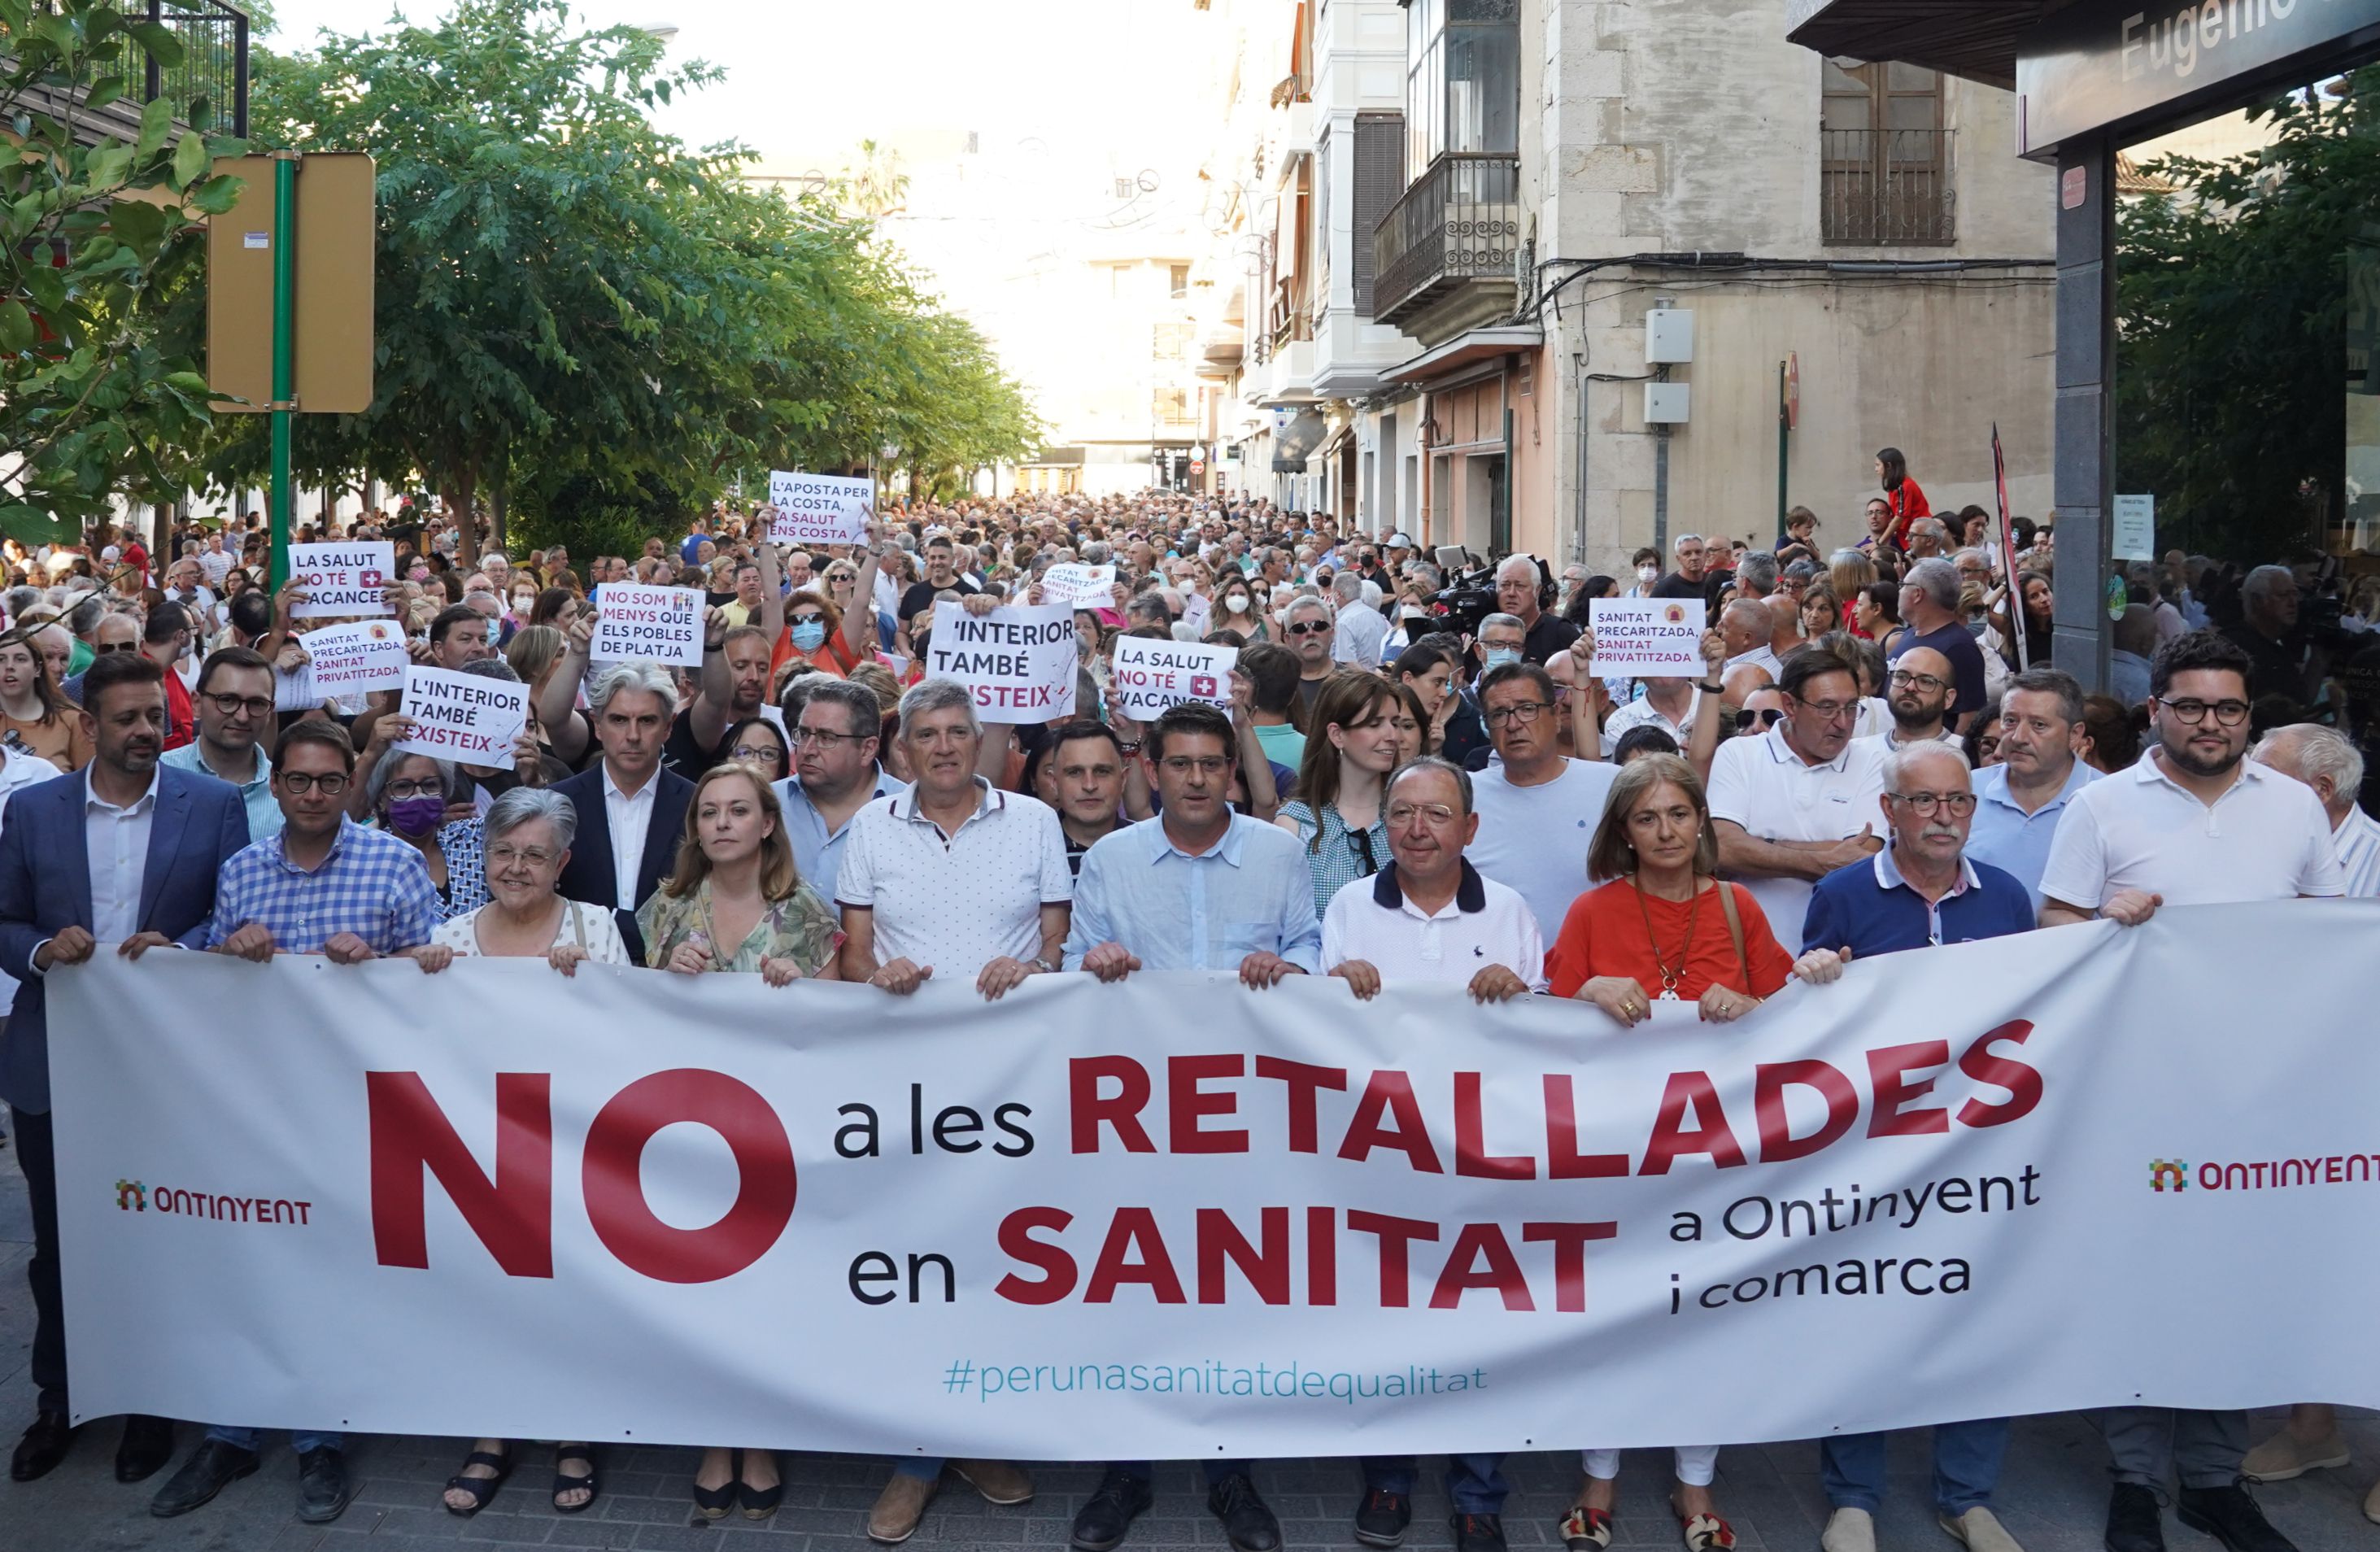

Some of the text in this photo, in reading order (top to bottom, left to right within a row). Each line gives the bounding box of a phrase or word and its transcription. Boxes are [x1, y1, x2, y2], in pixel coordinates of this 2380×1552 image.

[773, 482, 869, 498] L'APOSTA PER
[773, 496, 844, 512] LA COSTA,
[791, 512, 836, 525] SALUT
[770, 525, 847, 538] ENS COSTA
[297, 554, 376, 567] LA SALUT
[327, 569, 347, 586] TÉ
[605, 592, 666, 606] NO SOM
[604, 608, 692, 625] MENYS QUE
[1598, 613, 1652, 623] SANITAT
[310, 634, 360, 648] SANITAT
[602, 625, 692, 642] ELS POBLES
[1598, 626, 1698, 639] PRECARITZADA,
[313, 641, 404, 658] PRECARITZADA,
[601, 642, 683, 658] DE PLATJA
[1598, 640, 1652, 650] SANITAT
[316, 656, 365, 671] SANITAT
[934, 650, 1029, 677] TAMBÉ
[1121, 649, 1214, 671] LA SALUT
[1598, 653, 1691, 663] PRIVATITZADA
[317, 666, 400, 684] PRIVATITZADA
[1118, 669, 1175, 689] NO TÉ
[412, 678, 521, 712] L'INTERIOR
[409, 700, 477, 726] TAMBÉ
[404, 724, 492, 752] EXISTEIX
[366, 1018, 2043, 1284] NO a les RETALLADES
[1669, 1164, 2041, 1242] a Ontinyent
[848, 1206, 1618, 1312] en SANITAT
[1671, 1258, 1971, 1315] i comarca
[942, 1359, 1489, 1405] #perunasanitatdequalitat
